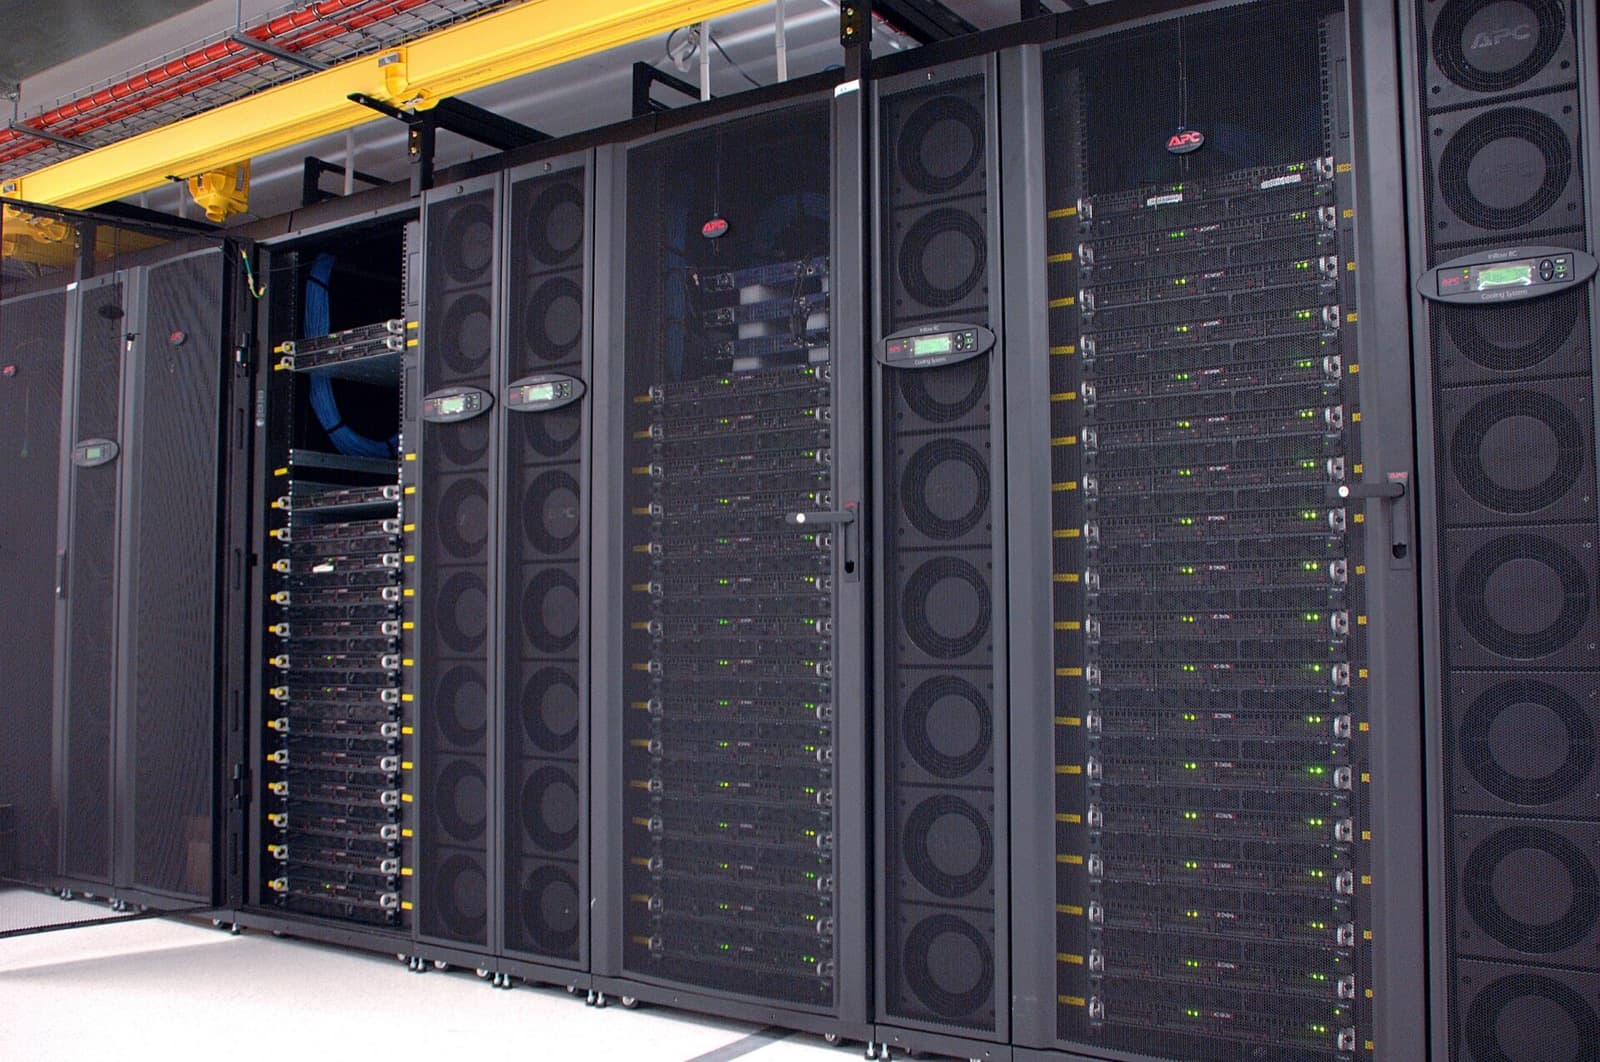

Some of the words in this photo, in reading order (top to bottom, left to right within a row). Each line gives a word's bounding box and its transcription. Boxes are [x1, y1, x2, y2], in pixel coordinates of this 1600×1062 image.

[1470, 24, 1531, 50] APC
[1168, 131, 1201, 147] APC
[703, 219, 726, 232] APC
